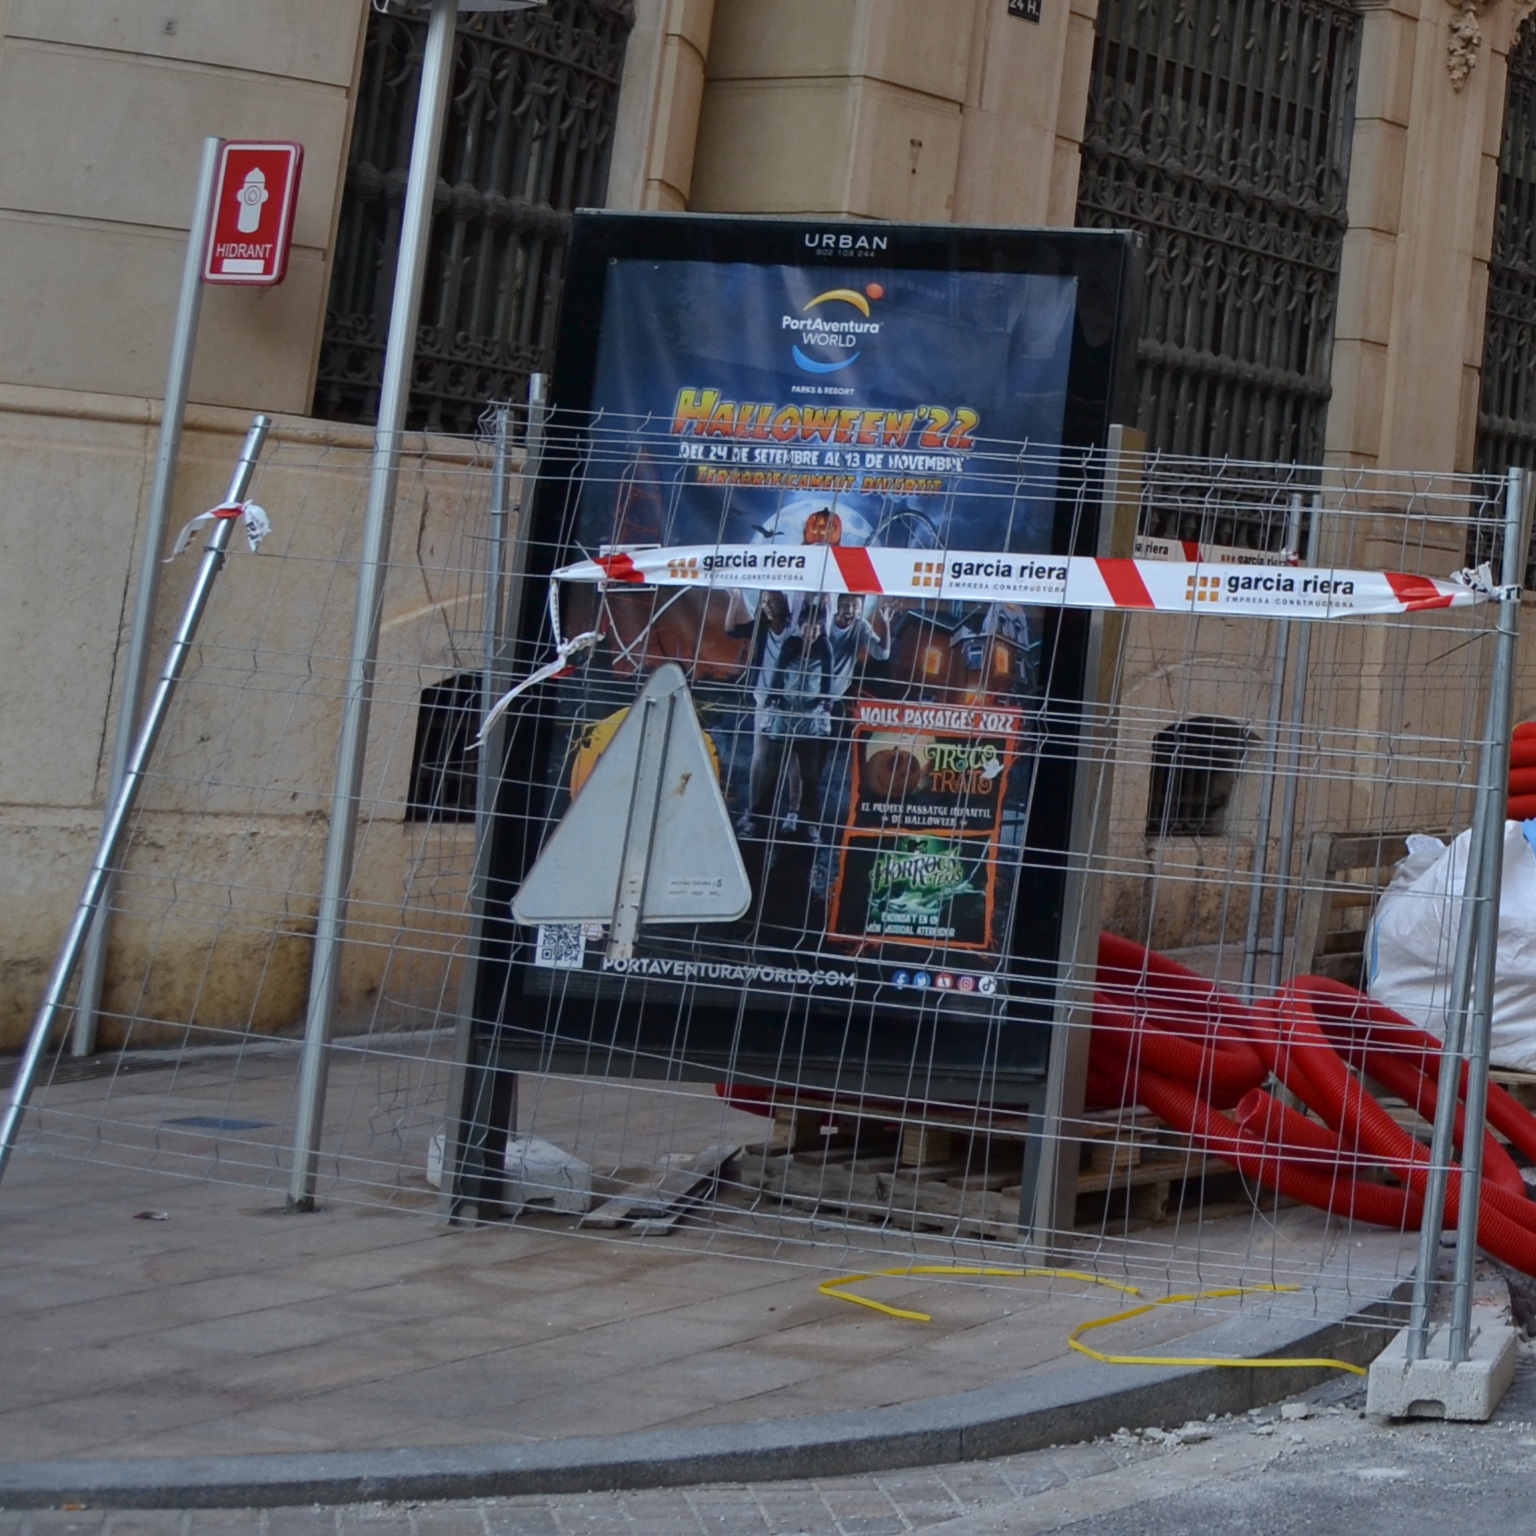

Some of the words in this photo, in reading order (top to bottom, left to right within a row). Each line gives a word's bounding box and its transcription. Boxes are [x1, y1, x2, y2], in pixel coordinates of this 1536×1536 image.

[804, 232, 888, 250] URBAN
[215, 243, 273, 259] HIDRANT
[816, 248, 834, 257] 902
[857, 250, 875, 258] 244
[781, 315, 880, 334] PortAventura
[802, 332, 857, 348] WORLD
[791, 385, 816, 395] PARKS
[817, 386, 823, 395] &
[824, 386, 856, 396] RESORT
[679, 441, 706, 460] DEL
[708, 444, 728, 462] 24
[731, 447, 750, 463] DE
[753, 447, 820, 466] SETEMBRE
[823, 450, 842, 467] AL
[844, 451, 861, 468] 13
[865, 453, 884, 469] DE
[861, 476, 944, 498] DIVERTIT
[1145, 539, 1169, 556] riera
[702, 550, 758, 572] garcia
[763, 550, 806, 569] riera
[704, 572, 739, 580] EMPRESA
[741, 573, 804, 581] CONSTRUCTORA
[950, 559, 1013, 580] garcia
[1018, 561, 1068, 581] riera
[949, 581, 989, 590] EMPRESA
[993, 582, 1066, 594] CONSTRUCTORA
[1226, 573, 1294, 594] garcia
[1302, 575, 1355, 596] riera
[1225, 594, 1270, 605] EMPRESA
[1275, 597, 1355, 609] CONSTRUCTORA
[904, 708, 975, 731] PASSATGES
[979, 713, 1015, 733] 2022
[928, 767, 993, 796] TRATO
[861, 802, 870, 812] EL
[872, 802, 904, 814] PRIMER
[905, 804, 948, 816] PASSATGE
[891, 814, 901, 824] DE
[904, 815, 957, 827] HALLOWEEN
[918, 914, 928, 925] EN
[602, 957, 856, 988] PORTAVENTURAWORLD.COM
